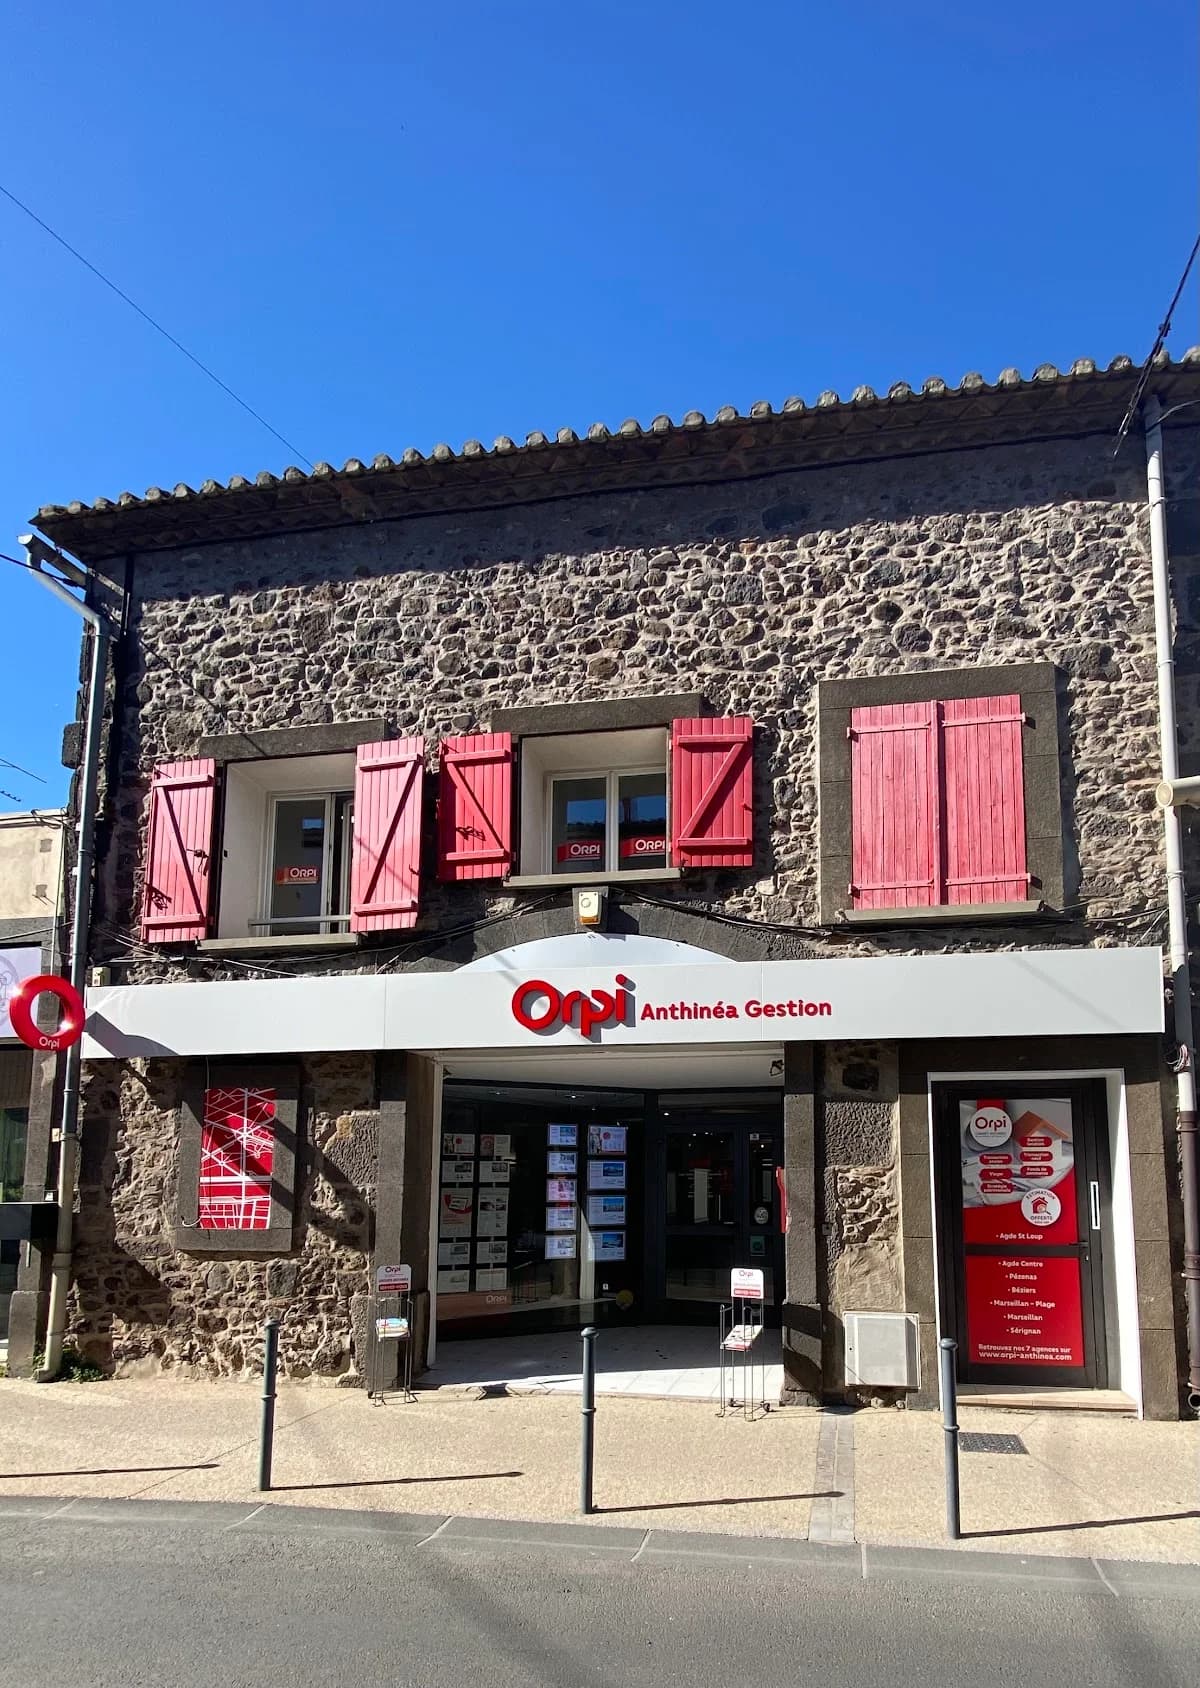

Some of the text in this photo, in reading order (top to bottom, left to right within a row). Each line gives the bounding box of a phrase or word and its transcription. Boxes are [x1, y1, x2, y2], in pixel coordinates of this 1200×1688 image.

[290, 867, 317, 878] ORPI
[512, 974, 832, 1037] Orpi Anthinéa Gestion
[39, 1036, 60, 1050] Orpi
[975, 1116, 1007, 1131] Orpi
[1011, 1286, 1036, 1294] Béziers
[1010, 1327, 1041, 1335] Sérignan
